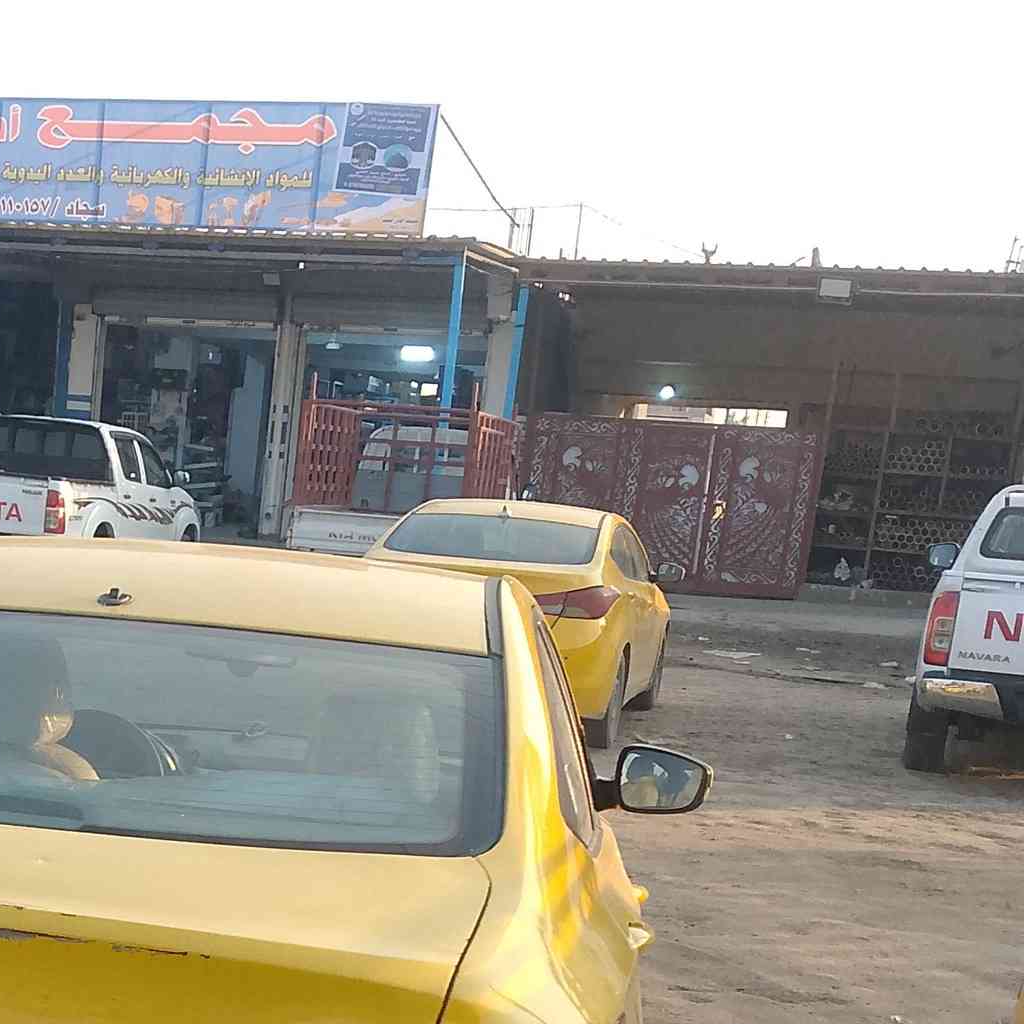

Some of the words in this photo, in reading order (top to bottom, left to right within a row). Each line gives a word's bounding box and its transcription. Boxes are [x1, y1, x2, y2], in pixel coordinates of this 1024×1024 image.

[2, 160, 52, 184] اليدوية
[56, 164, 104, 187] والعدد
[264, 168, 313, 192] للمواد
[958, 650, 1011, 664] NAVARA
